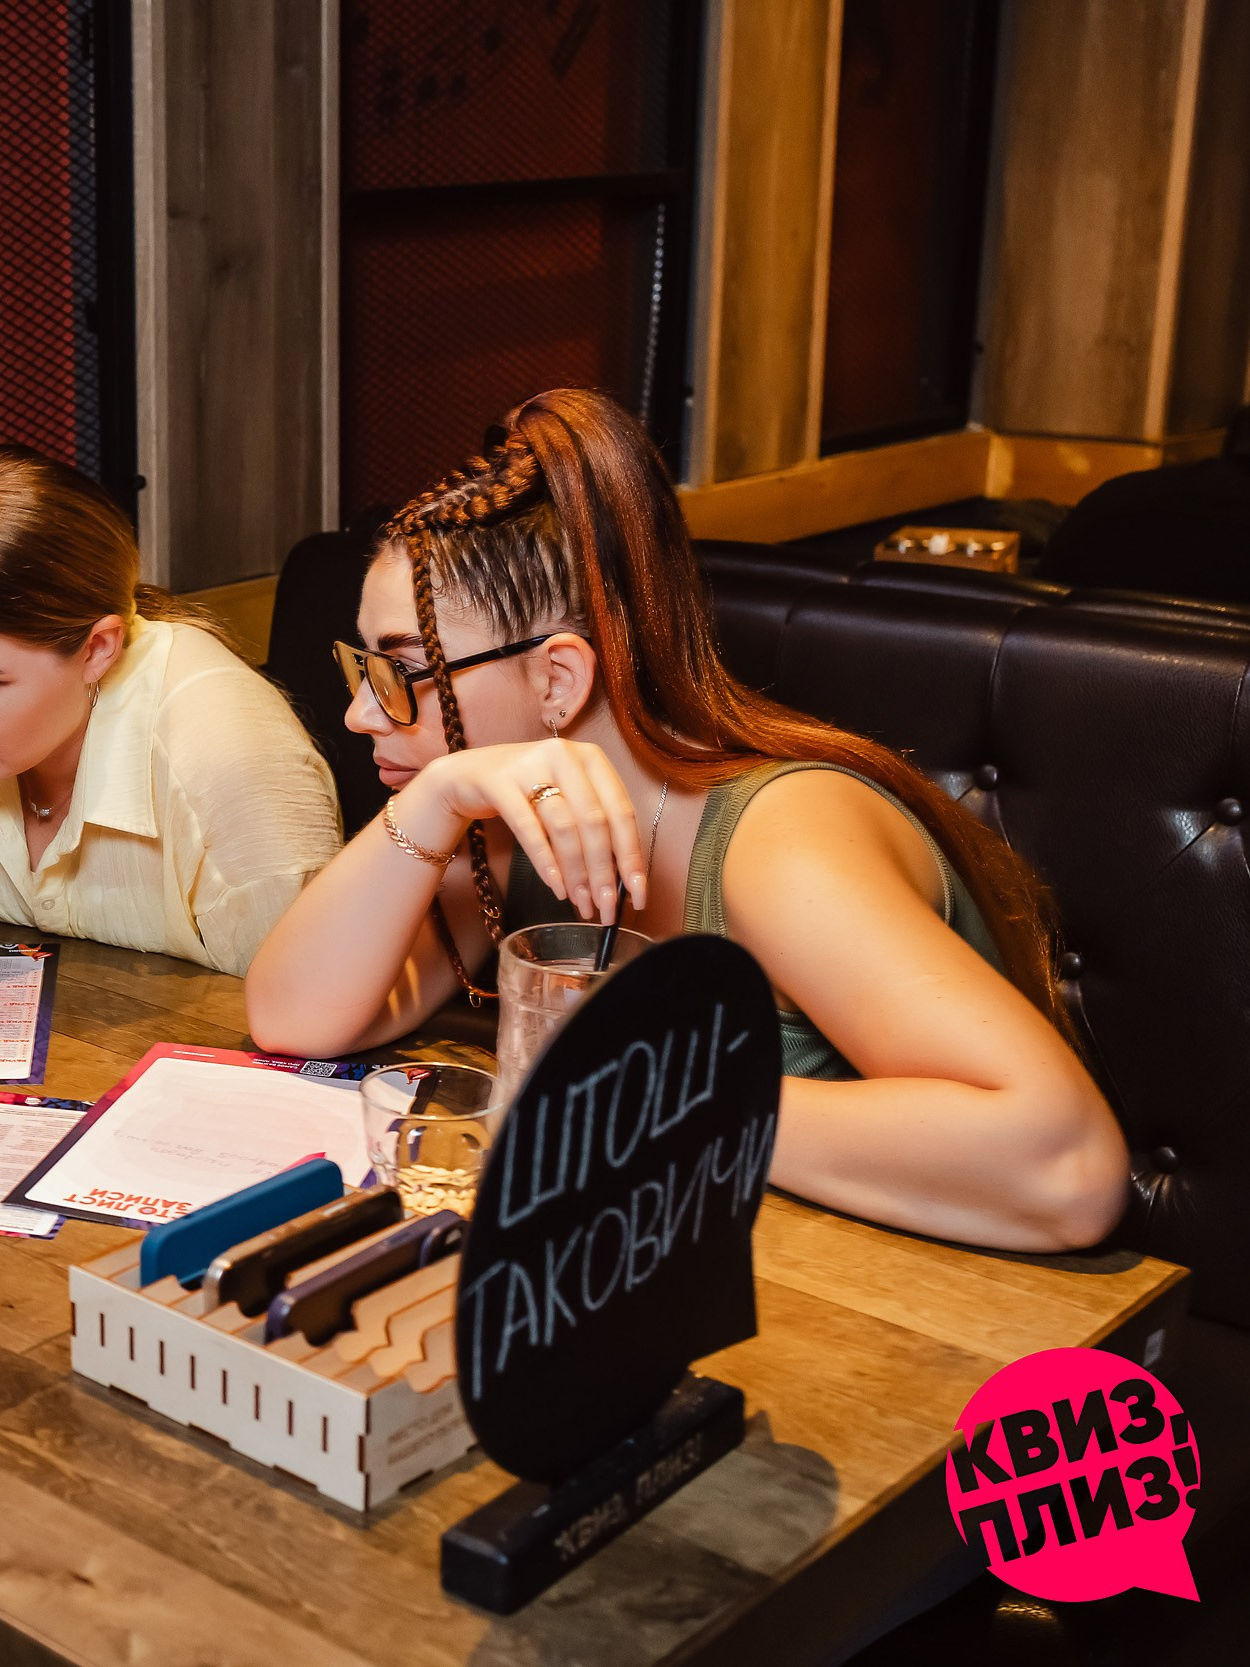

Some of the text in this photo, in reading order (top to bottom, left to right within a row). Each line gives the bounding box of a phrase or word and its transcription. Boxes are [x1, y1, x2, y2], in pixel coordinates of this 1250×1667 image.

[498, 1003, 749, 1229] ШТОШ-
[63, 1194, 134, 1211] ЛИСТ
[90, 1188, 192, 1211] ЗАПИСИ
[461, 1112, 775, 1401] ТАКОВИЧИ
